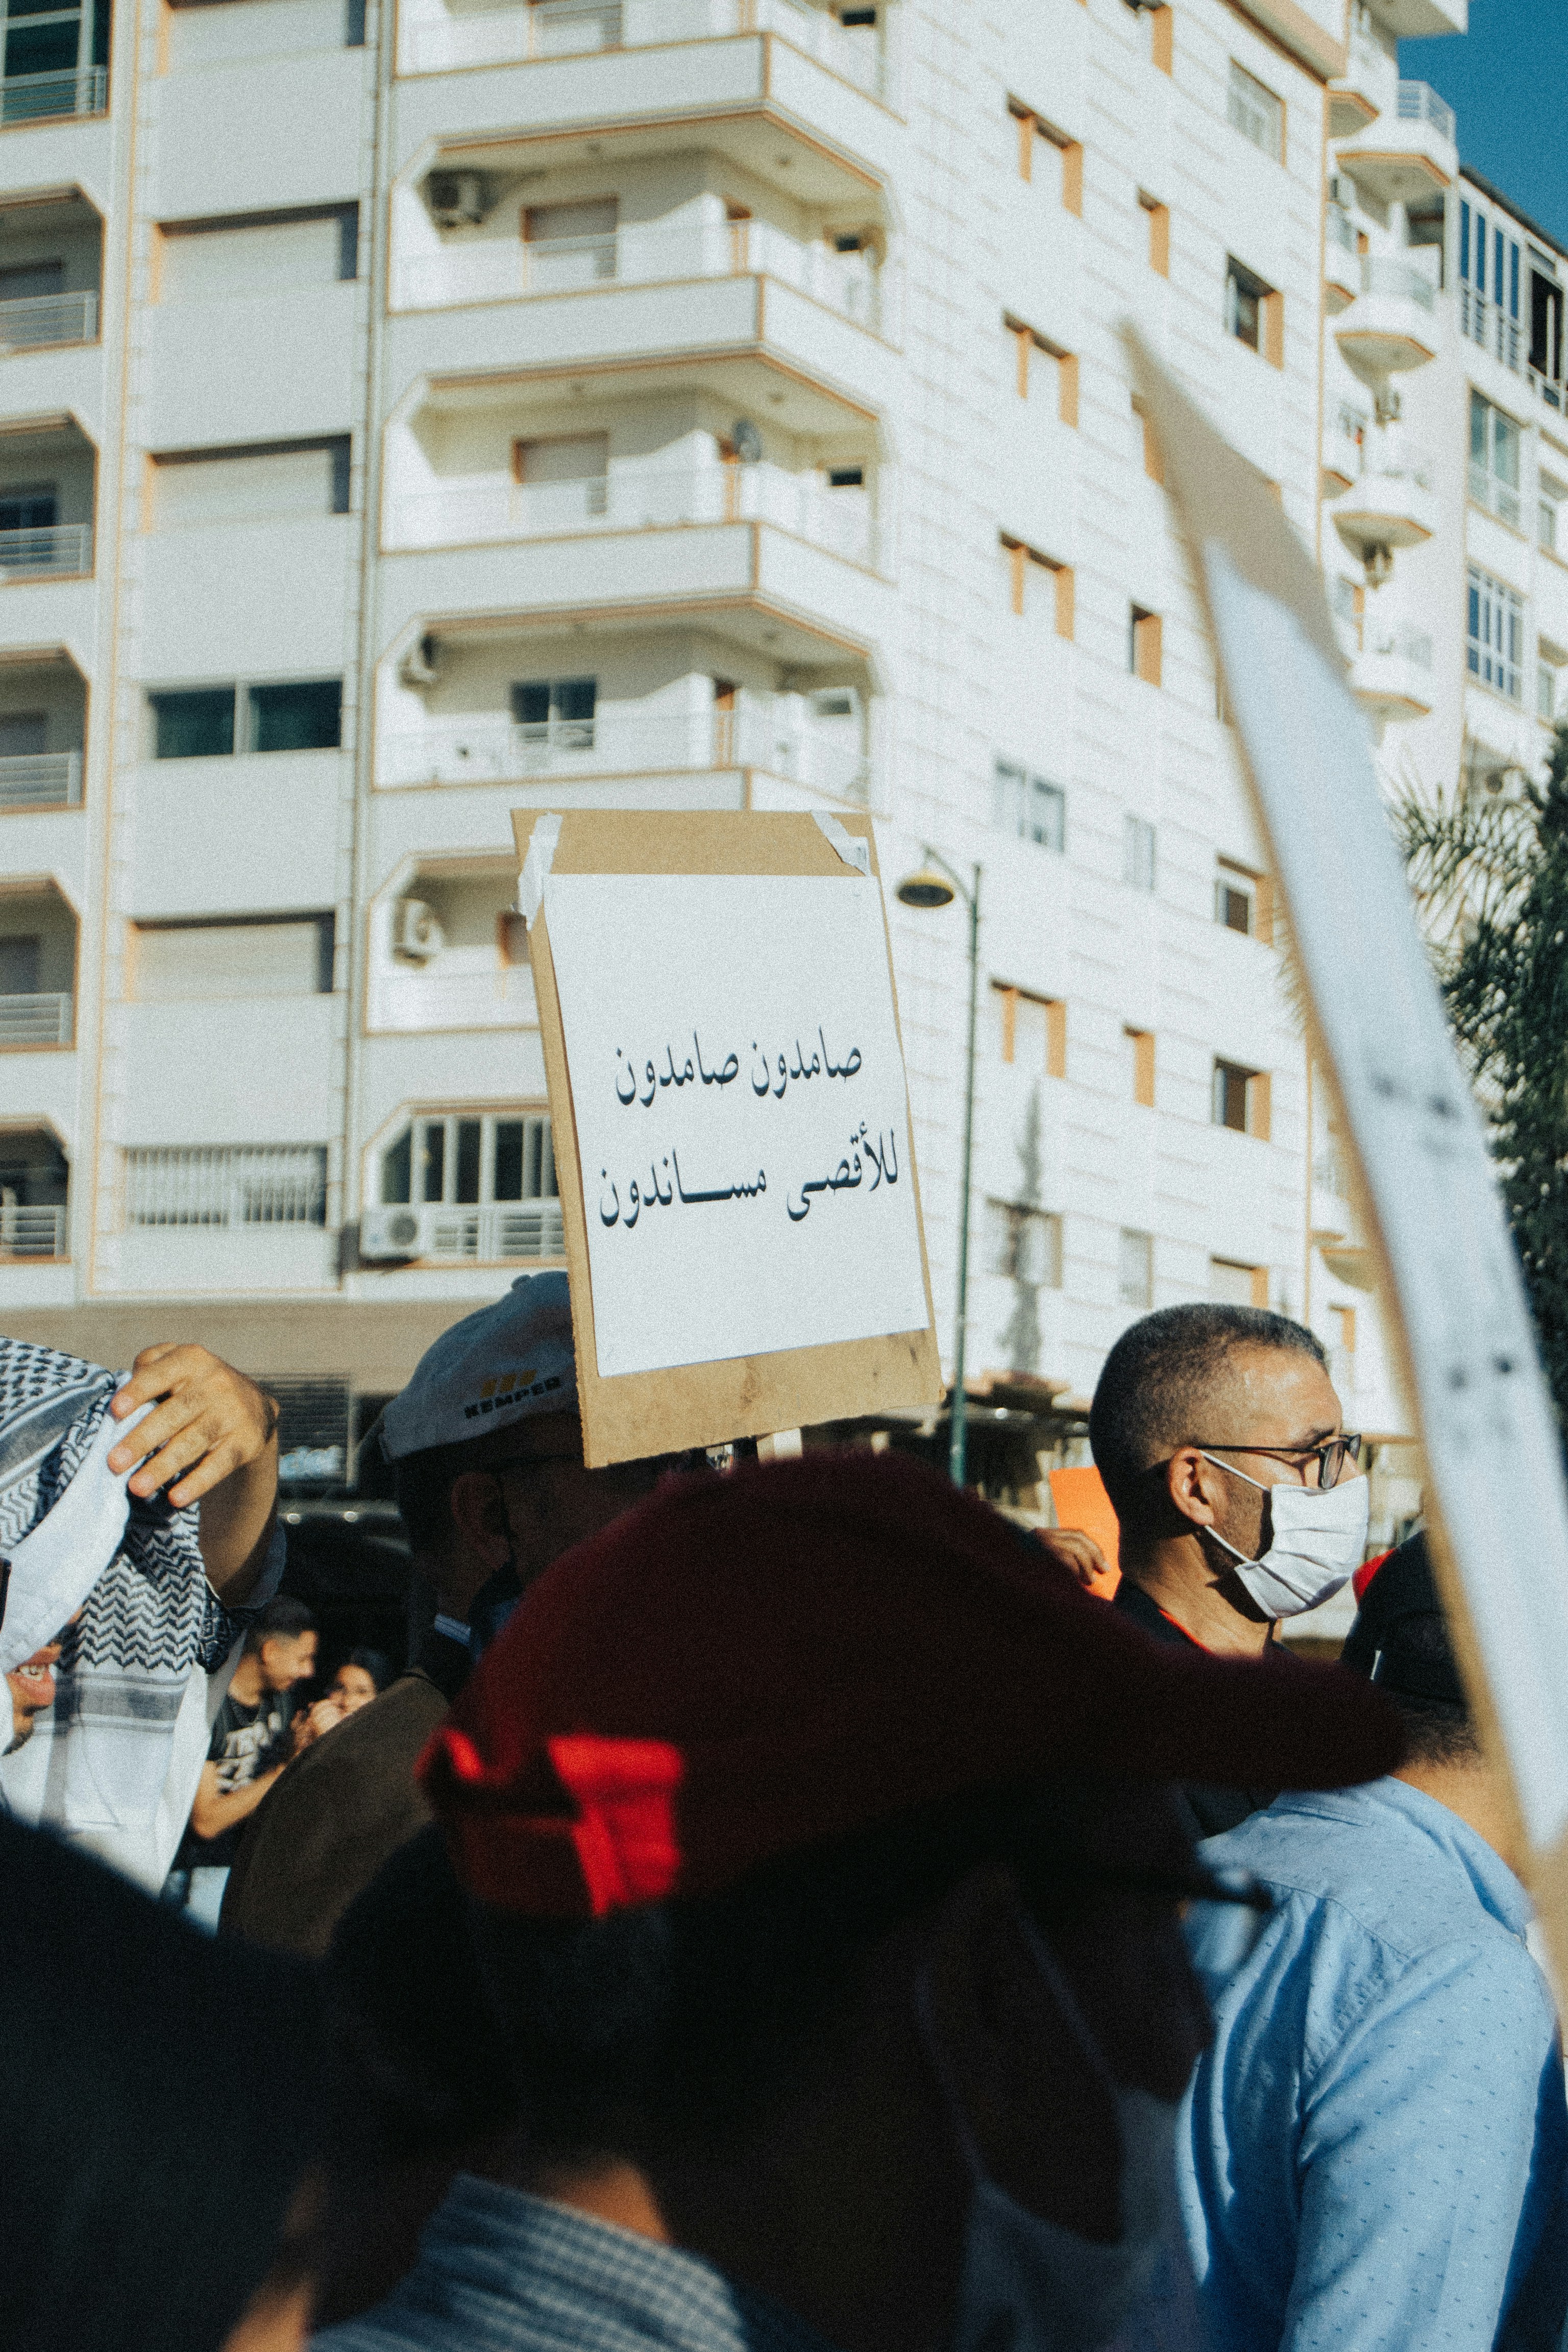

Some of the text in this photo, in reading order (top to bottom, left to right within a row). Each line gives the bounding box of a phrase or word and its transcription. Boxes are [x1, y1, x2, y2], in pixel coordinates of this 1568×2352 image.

[616, 1024, 862, 1108] صامدون صامدون
[600, 1120, 898, 1229] للأقصى مساندون
[464, 1376, 561, 1418] KEMPER
